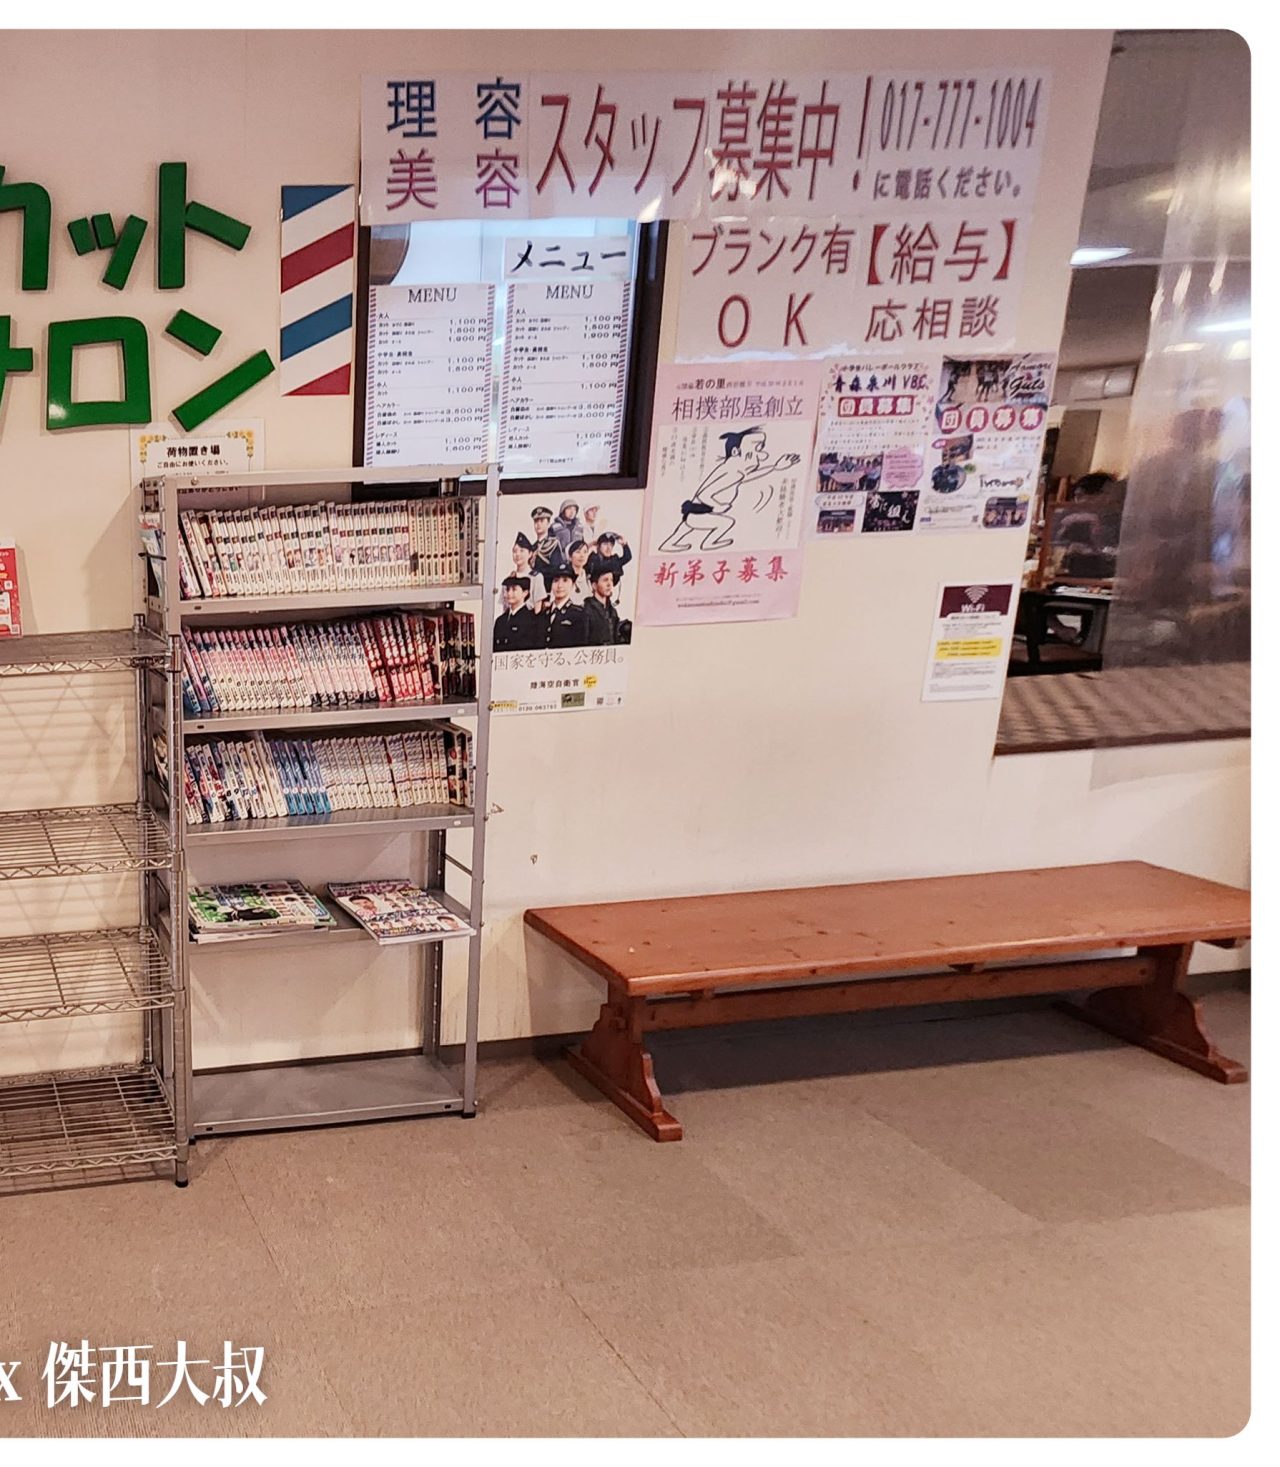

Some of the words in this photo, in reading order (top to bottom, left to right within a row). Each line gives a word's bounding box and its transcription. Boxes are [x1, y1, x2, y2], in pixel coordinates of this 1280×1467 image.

[880, 78, 1042, 150] 017-777-1004
[873, 166, 1020, 200] に電話ください。
[511, 240, 626, 273] メニュー
[692, 222, 855, 276] ブランク有
[867, 219, 1017, 286] 【給与】
[408, 287, 457, 303] MENU
[545, 285, 593, 300] MENU
[865, 295, 1001, 342] 応相談
[672, 395, 804, 421] 相撲部屋創立
[167, 444, 221, 458] 荷物置き場
[654, 555, 789, 589] 新弟子募集
[494, 648, 625, 671] 国家を守る、公務員。
